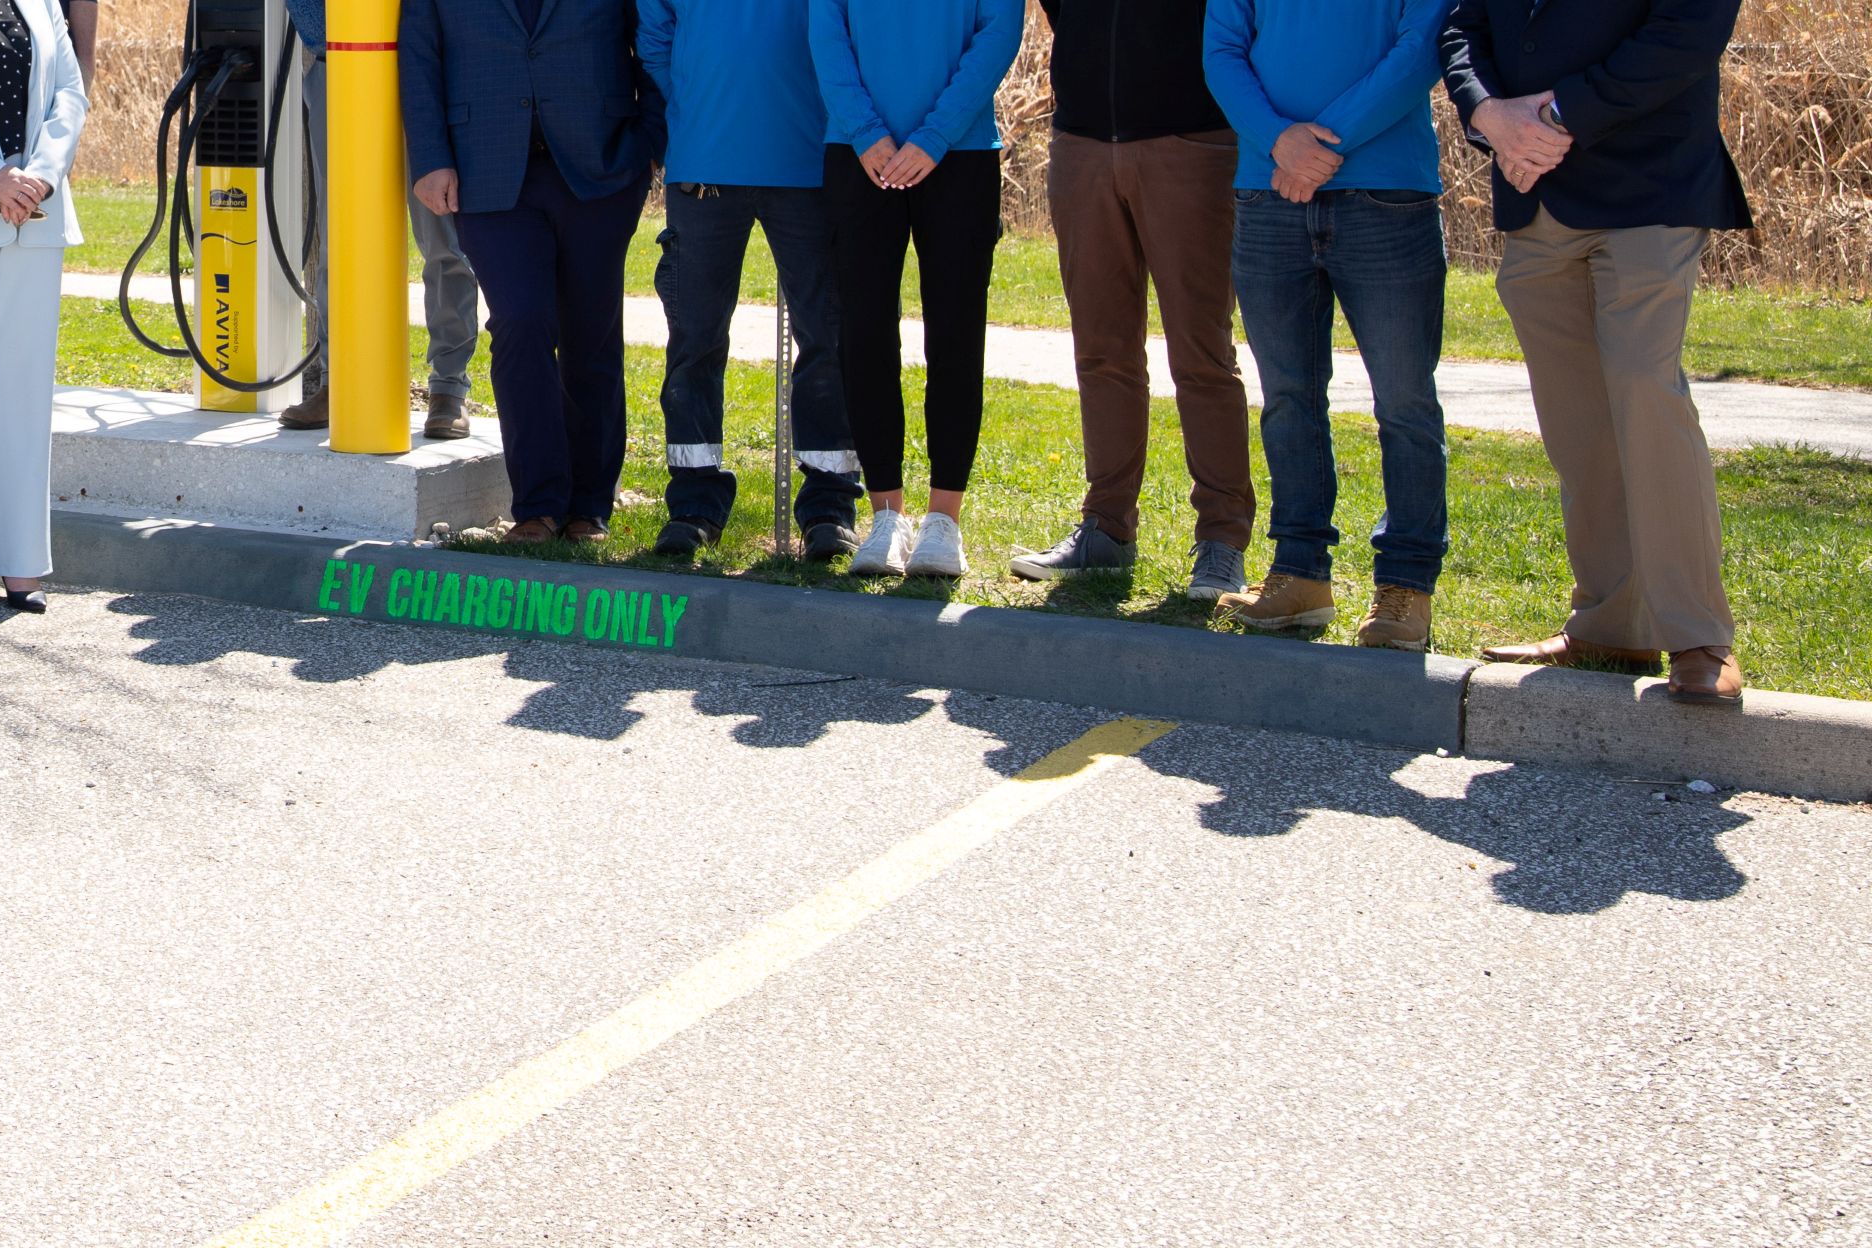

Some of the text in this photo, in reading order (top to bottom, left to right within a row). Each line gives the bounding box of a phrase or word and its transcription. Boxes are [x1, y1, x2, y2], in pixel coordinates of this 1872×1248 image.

[211, 197, 245, 206] Lakeshore
[215, 298, 230, 374] AVIVA
[318, 559, 688, 648] EV CHARGING ONLY
